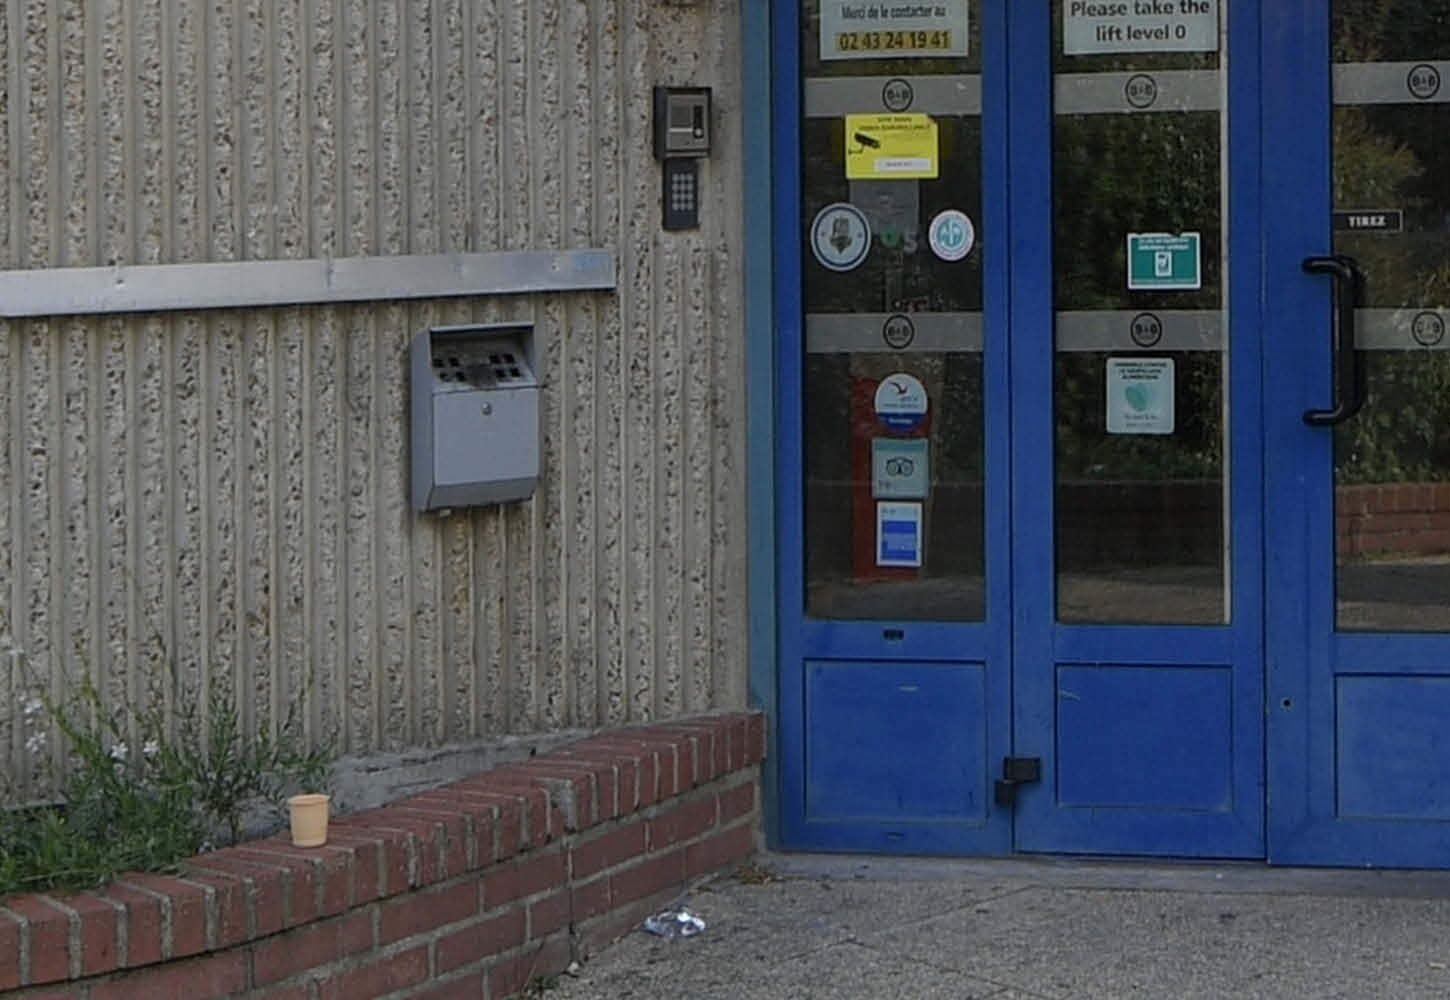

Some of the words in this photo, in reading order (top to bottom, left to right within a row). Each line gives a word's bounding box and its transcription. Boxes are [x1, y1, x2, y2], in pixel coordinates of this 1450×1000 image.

[1070, 1, 1128, 17] Please
[1134, 0, 1174, 16] take
[839, 32, 858, 51] 02
[885, 32, 904, 49] 24
[910, 31, 927, 48] 19
[930, 31, 950, 49] 41
[1096, 25, 1123, 42] lift
[1127, 24, 1170, 41] level
[1175, 25, 1187, 40] 0
